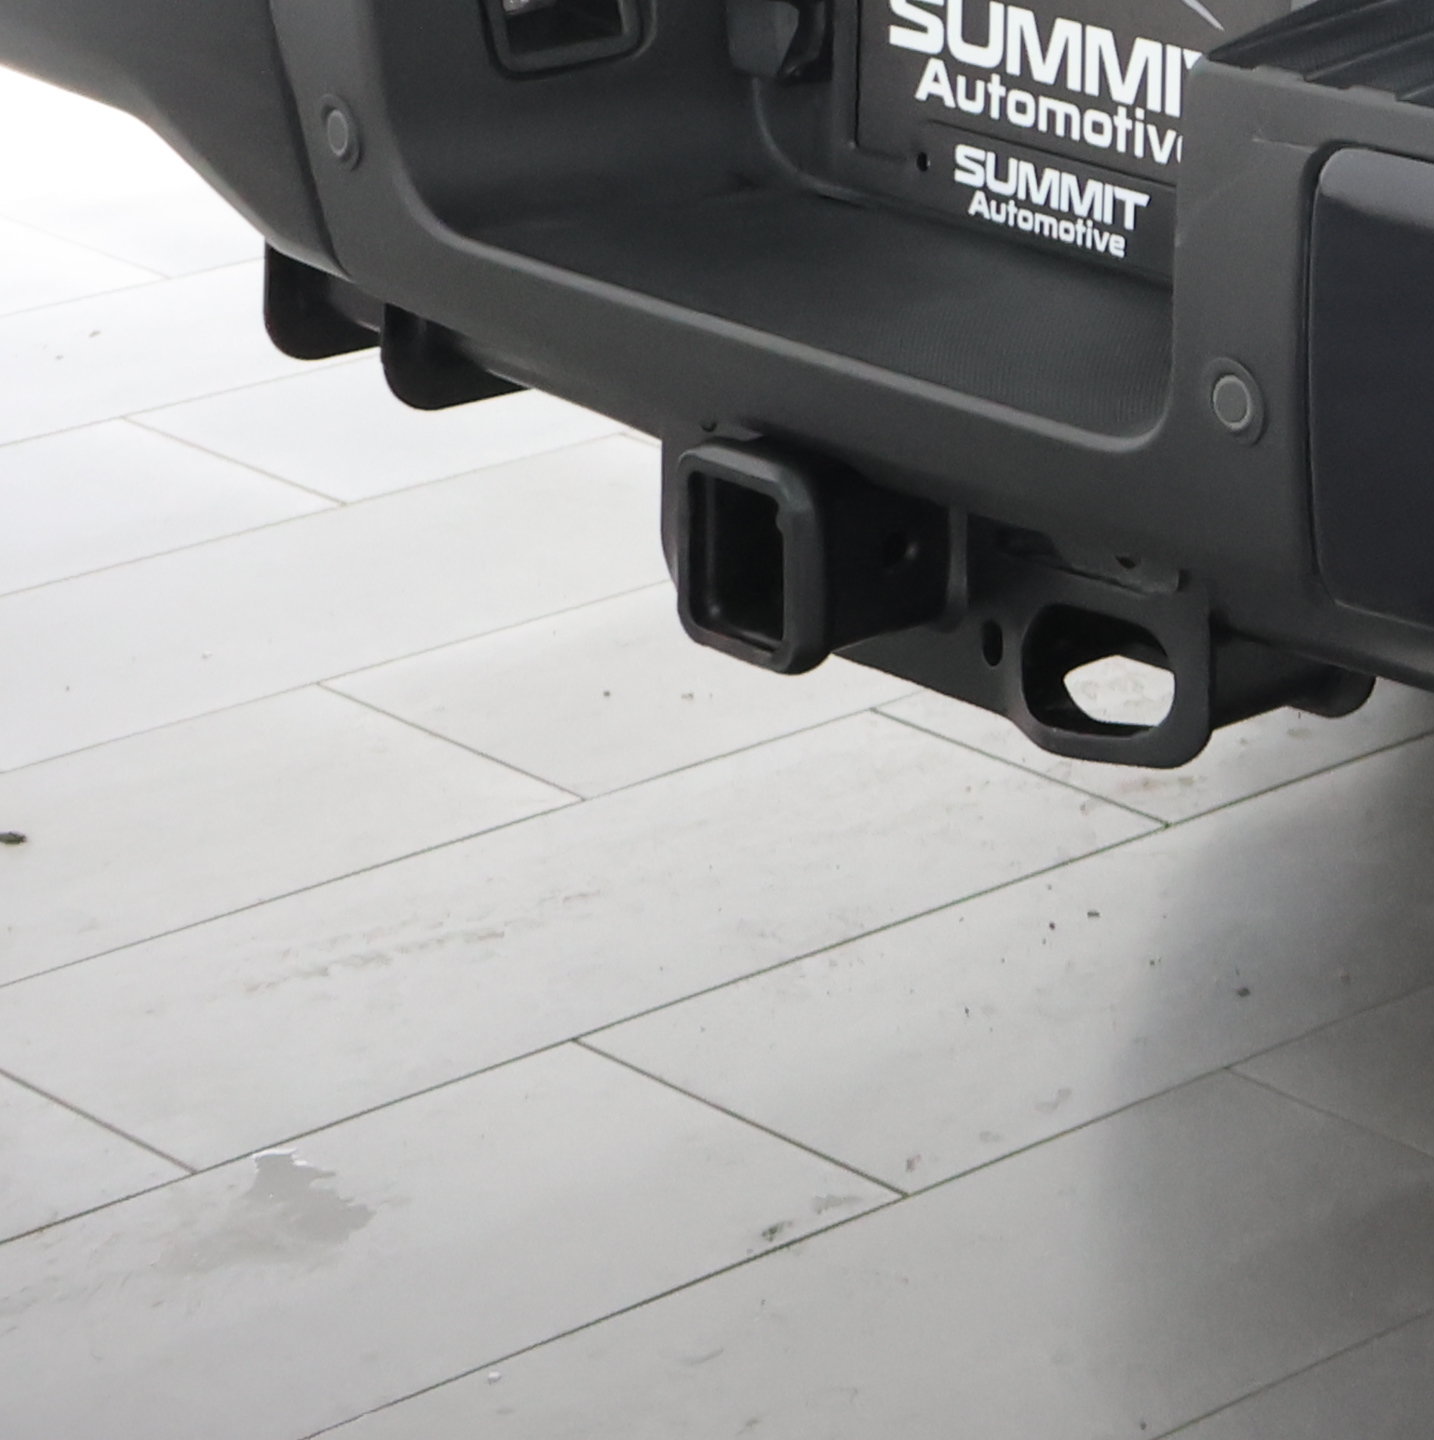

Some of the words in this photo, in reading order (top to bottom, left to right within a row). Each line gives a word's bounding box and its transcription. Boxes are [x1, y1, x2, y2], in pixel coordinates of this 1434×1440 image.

[915, 57, 1184, 166] Automotiv
[954, 143, 1151, 231] SUMMIT
[967, 190, 1126, 259] Automotive
